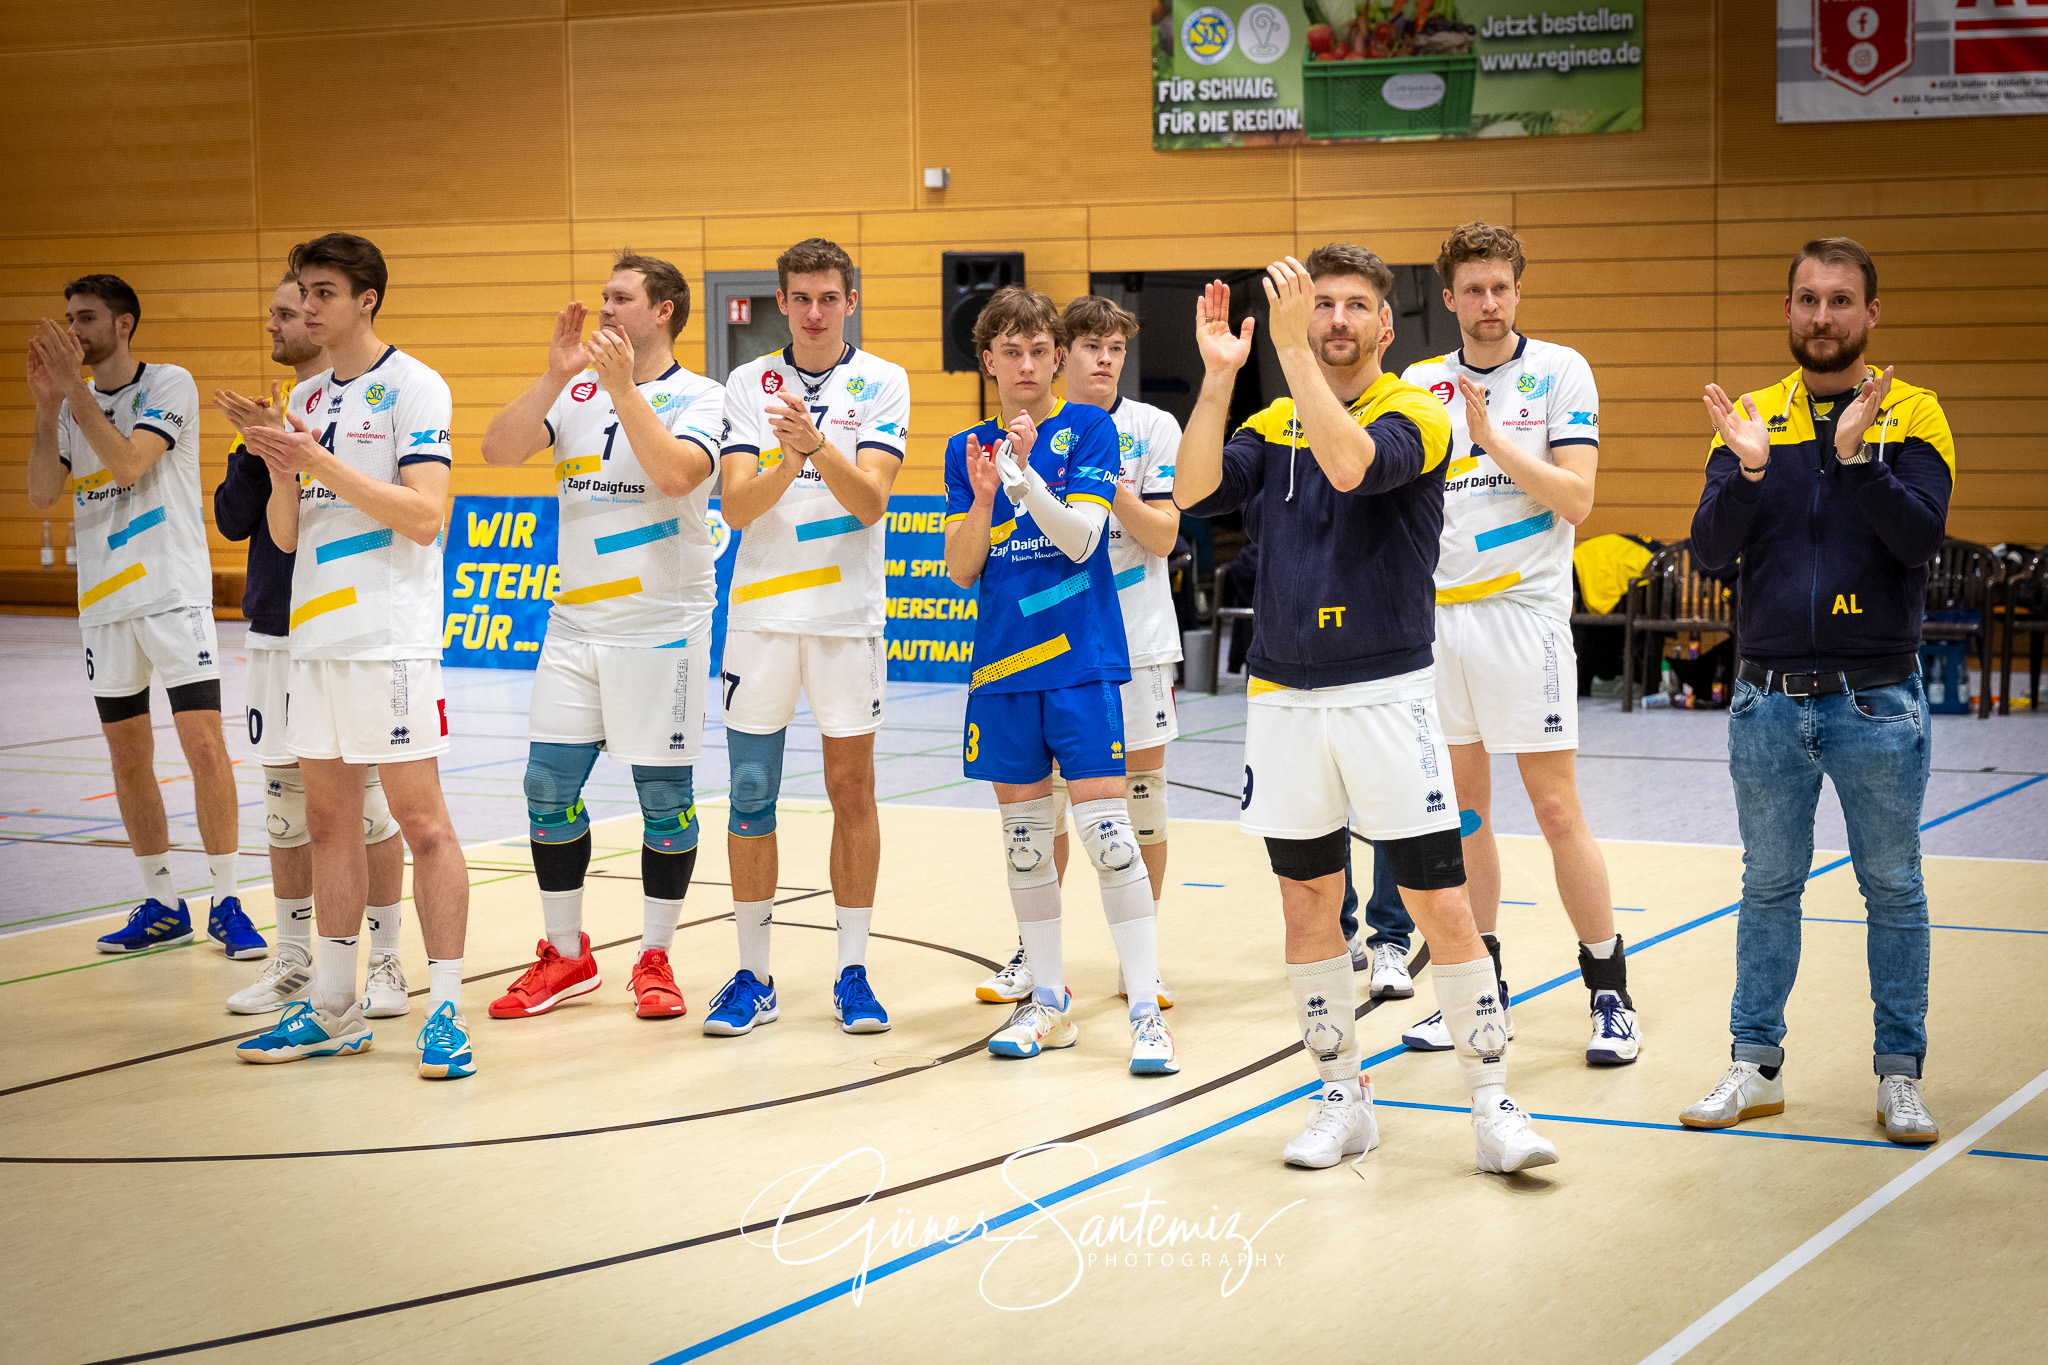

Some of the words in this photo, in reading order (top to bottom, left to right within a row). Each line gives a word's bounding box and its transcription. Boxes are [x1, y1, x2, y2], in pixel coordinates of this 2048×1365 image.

[1481, 14, 1537, 38] Jetzt
[1541, 8, 1634, 34] bestellen
[1480, 41, 1641, 73] www.regineo.de
[1158, 76, 1195, 102] FÜR
[1198, 76, 1278, 101] SCHWAIG.
[1159, 108, 1195, 134] FÜR
[1198, 110, 1230, 132] DIE
[1232, 108, 1303, 132] REGION.
[1502, 419, 1545, 427] Heinzelmann
[318, 422, 337, 455] 4
[346, 432, 386, 440] Heinzelmann
[602, 422, 619, 460] 1
[568, 477, 591, 490] Zapf
[592, 479, 645, 494] Daigfuss
[797, 469, 821, 481] Daig
[1444, 478, 1469, 492] Zapf
[1471, 473, 1516, 488] Daigfu
[87, 488, 109, 501] Zapf
[317, 488, 339, 500] Daig
[467, 511, 537, 549] WIR
[885, 512, 946, 533] TIONE
[990, 542, 1009, 557] Zap
[1011, 535, 1055, 551] Daigfu
[910, 559, 951, 577] SPIT
[452, 562, 561, 600] STEHE
[1832, 594, 1862, 614] AL
[1318, 606, 1346, 628] FT
[885, 639, 974, 662] AUTNAH
[85, 647, 94, 681] 6
[723, 669, 740, 711] 7
[246, 705, 263, 745] 0
[390, 737, 410, 745] errea
[966, 723, 980, 762] 3
[1427, 802, 1446, 813] errea
[1013, 835, 1030, 843] errea
[1100, 828, 1118, 841] errea
[1307, 1008, 1328, 1018] errea
[1476, 1006, 1497, 1017] errea
